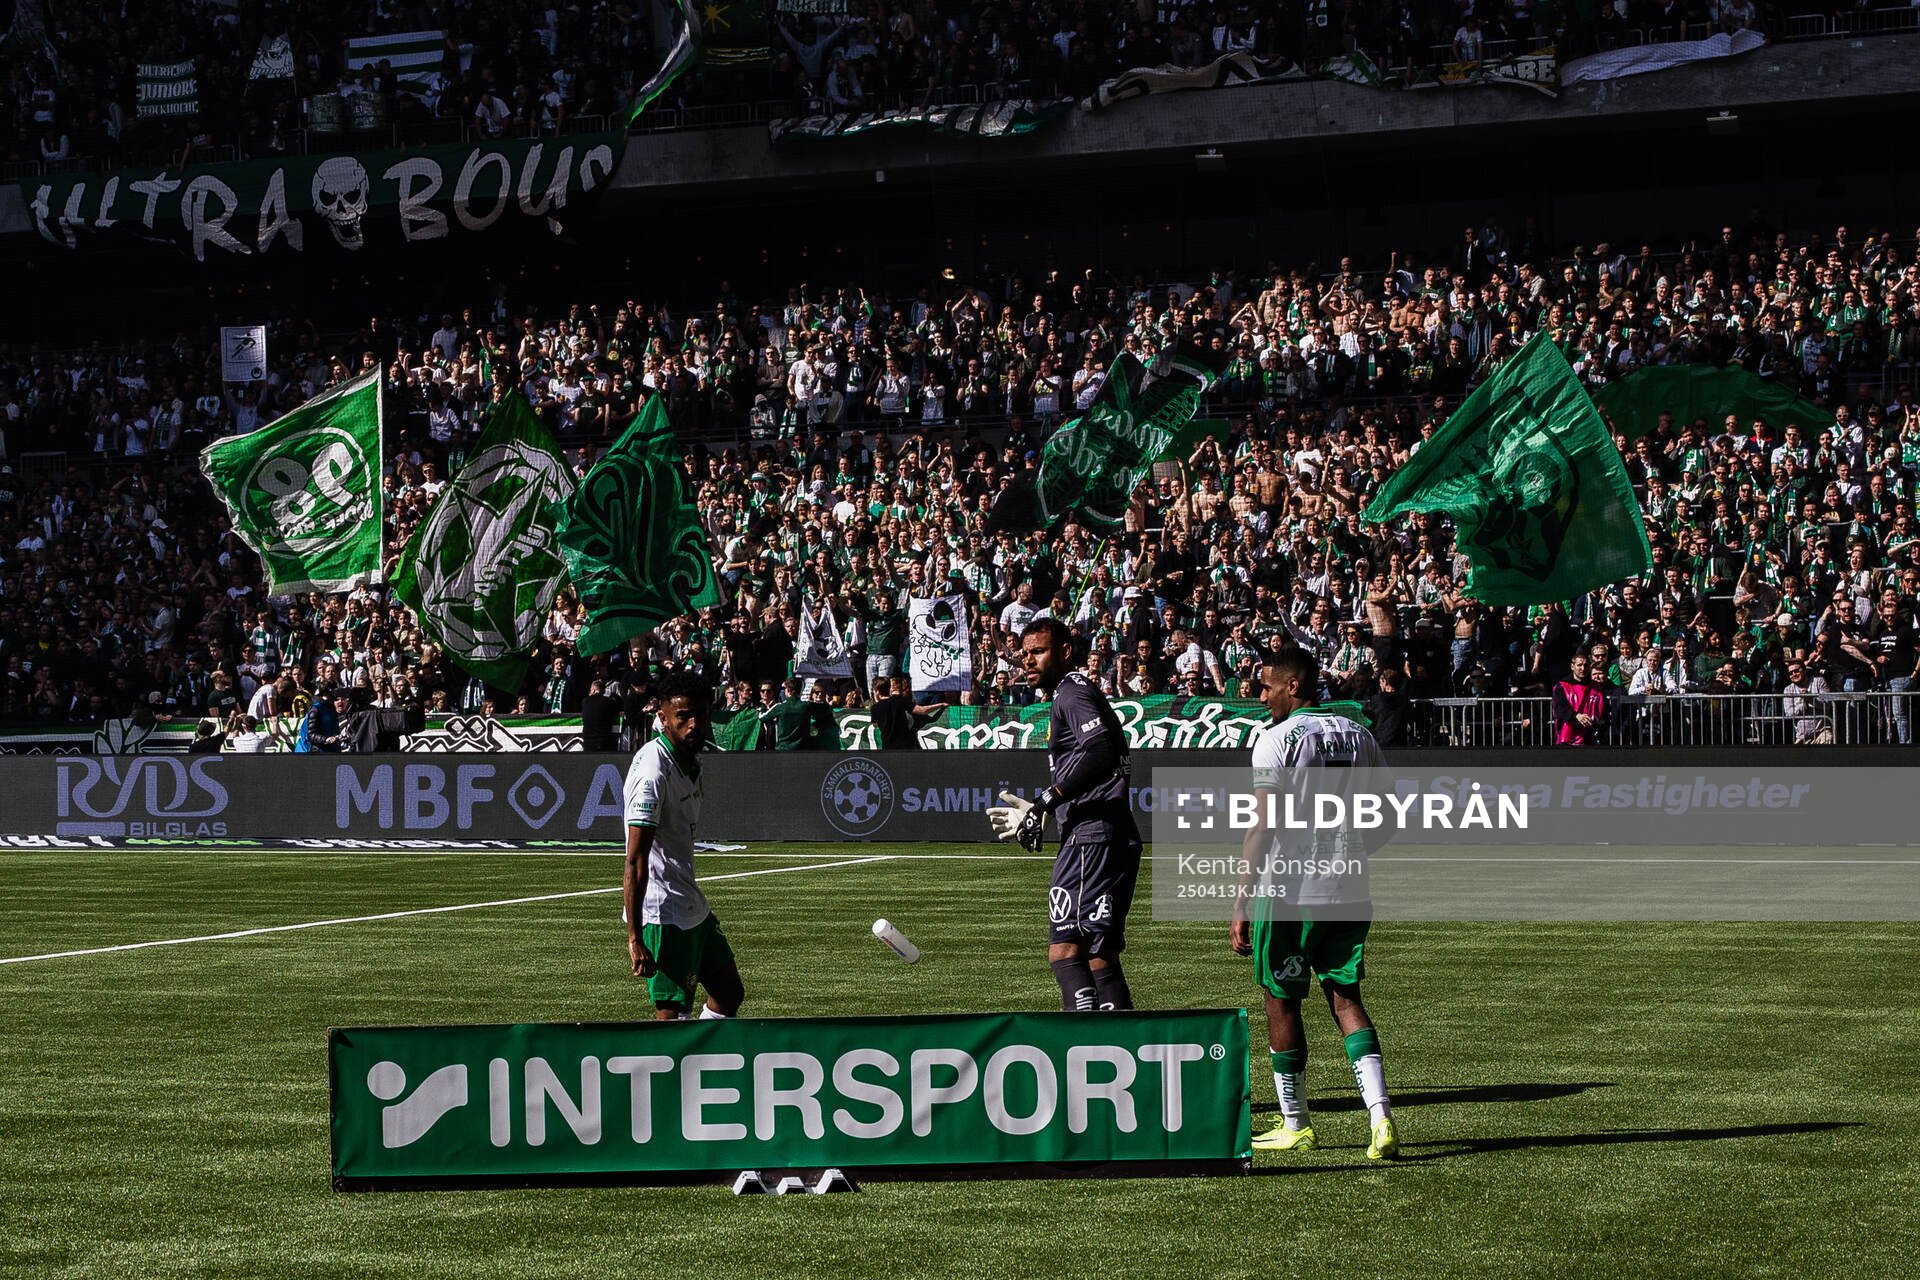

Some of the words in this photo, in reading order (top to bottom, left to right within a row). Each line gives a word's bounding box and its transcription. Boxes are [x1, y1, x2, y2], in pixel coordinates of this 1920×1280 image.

[55, 756, 229, 818] RYDS
[335, 763, 497, 830] MBF
[1560, 775, 1811, 815] Fastigheter
[129, 821, 228, 837] BILGLAS
